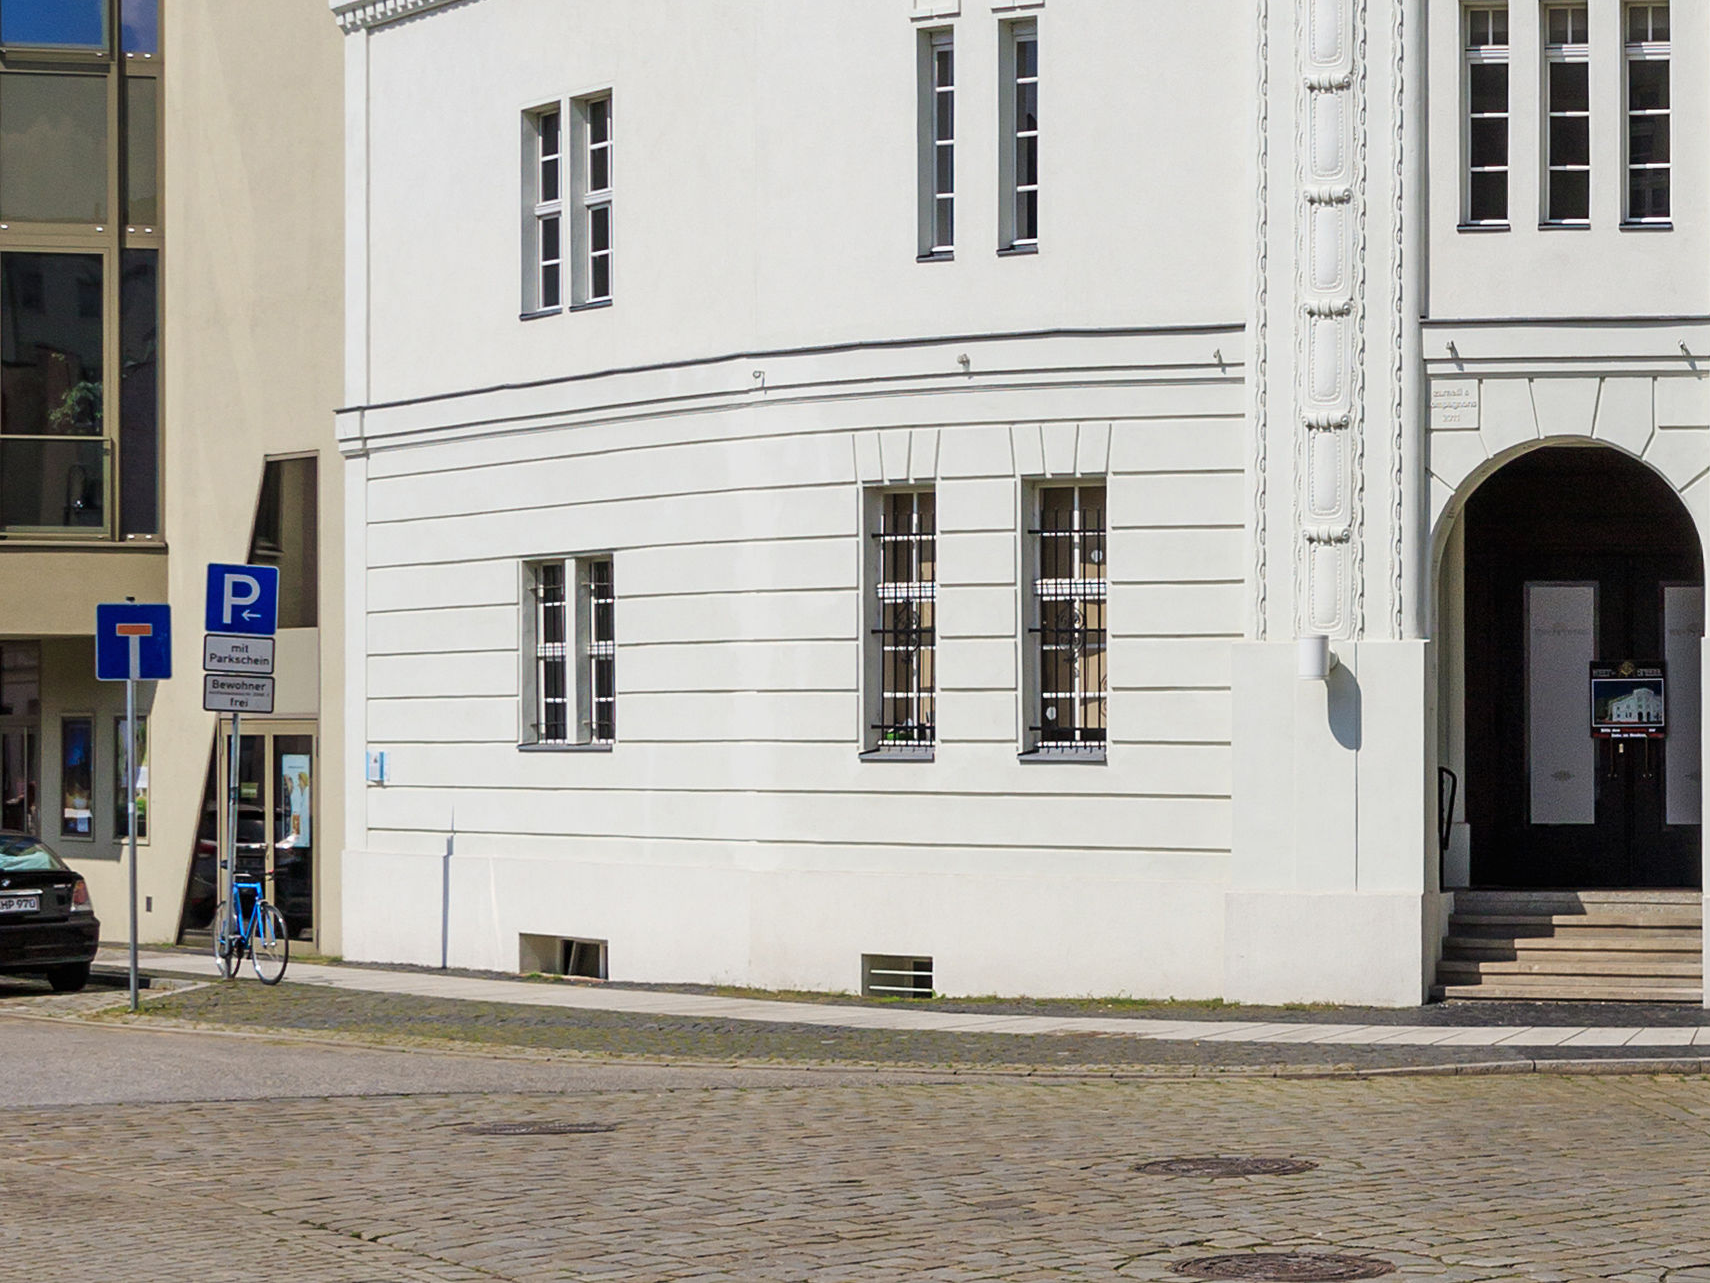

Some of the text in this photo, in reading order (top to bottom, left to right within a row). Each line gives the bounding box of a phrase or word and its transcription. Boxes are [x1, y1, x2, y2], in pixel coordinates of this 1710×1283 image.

[222, 573, 261, 624] P
[230, 644, 249, 653] mit
[209, 652, 270, 666] Parkschein
[211, 679, 267, 692] Bewohner
[230, 697, 249, 708] frei
